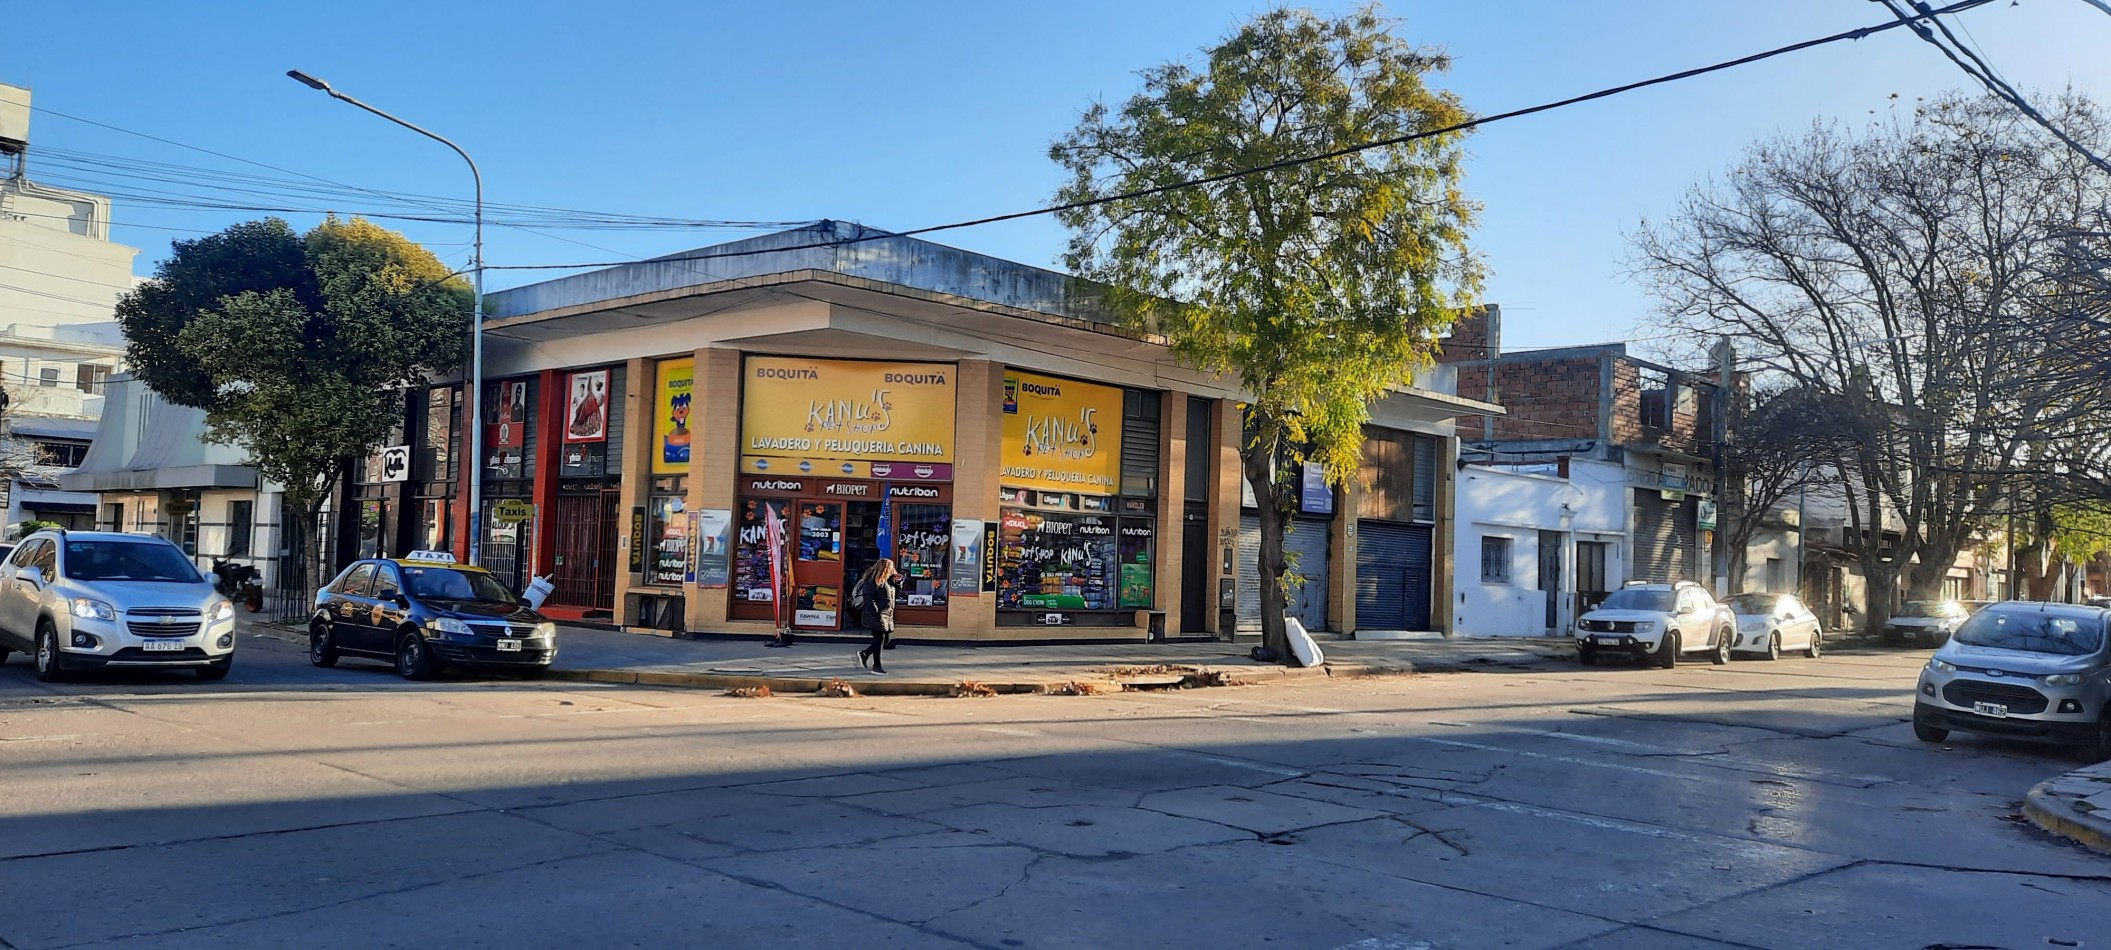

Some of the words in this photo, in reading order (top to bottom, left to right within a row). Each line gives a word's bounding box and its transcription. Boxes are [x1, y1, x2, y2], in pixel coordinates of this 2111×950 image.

[751, 436, 811, 451] LAVADERO
[814, 438, 822, 451] Y
[824, 440, 895, 456] PELUQUERIA
[898, 442, 943, 456] CANINA
[1038, 469, 1043, 478] Y
[1044, 470, 1086, 485] PELUQUERIA
[1088, 474, 1115, 487] CANINA
[752, 480, 802, 490] nutribon
[889, 486, 939, 497] nutribon
[498, 506, 527, 517] Taxis
[415, 551, 451, 560] TAXI
